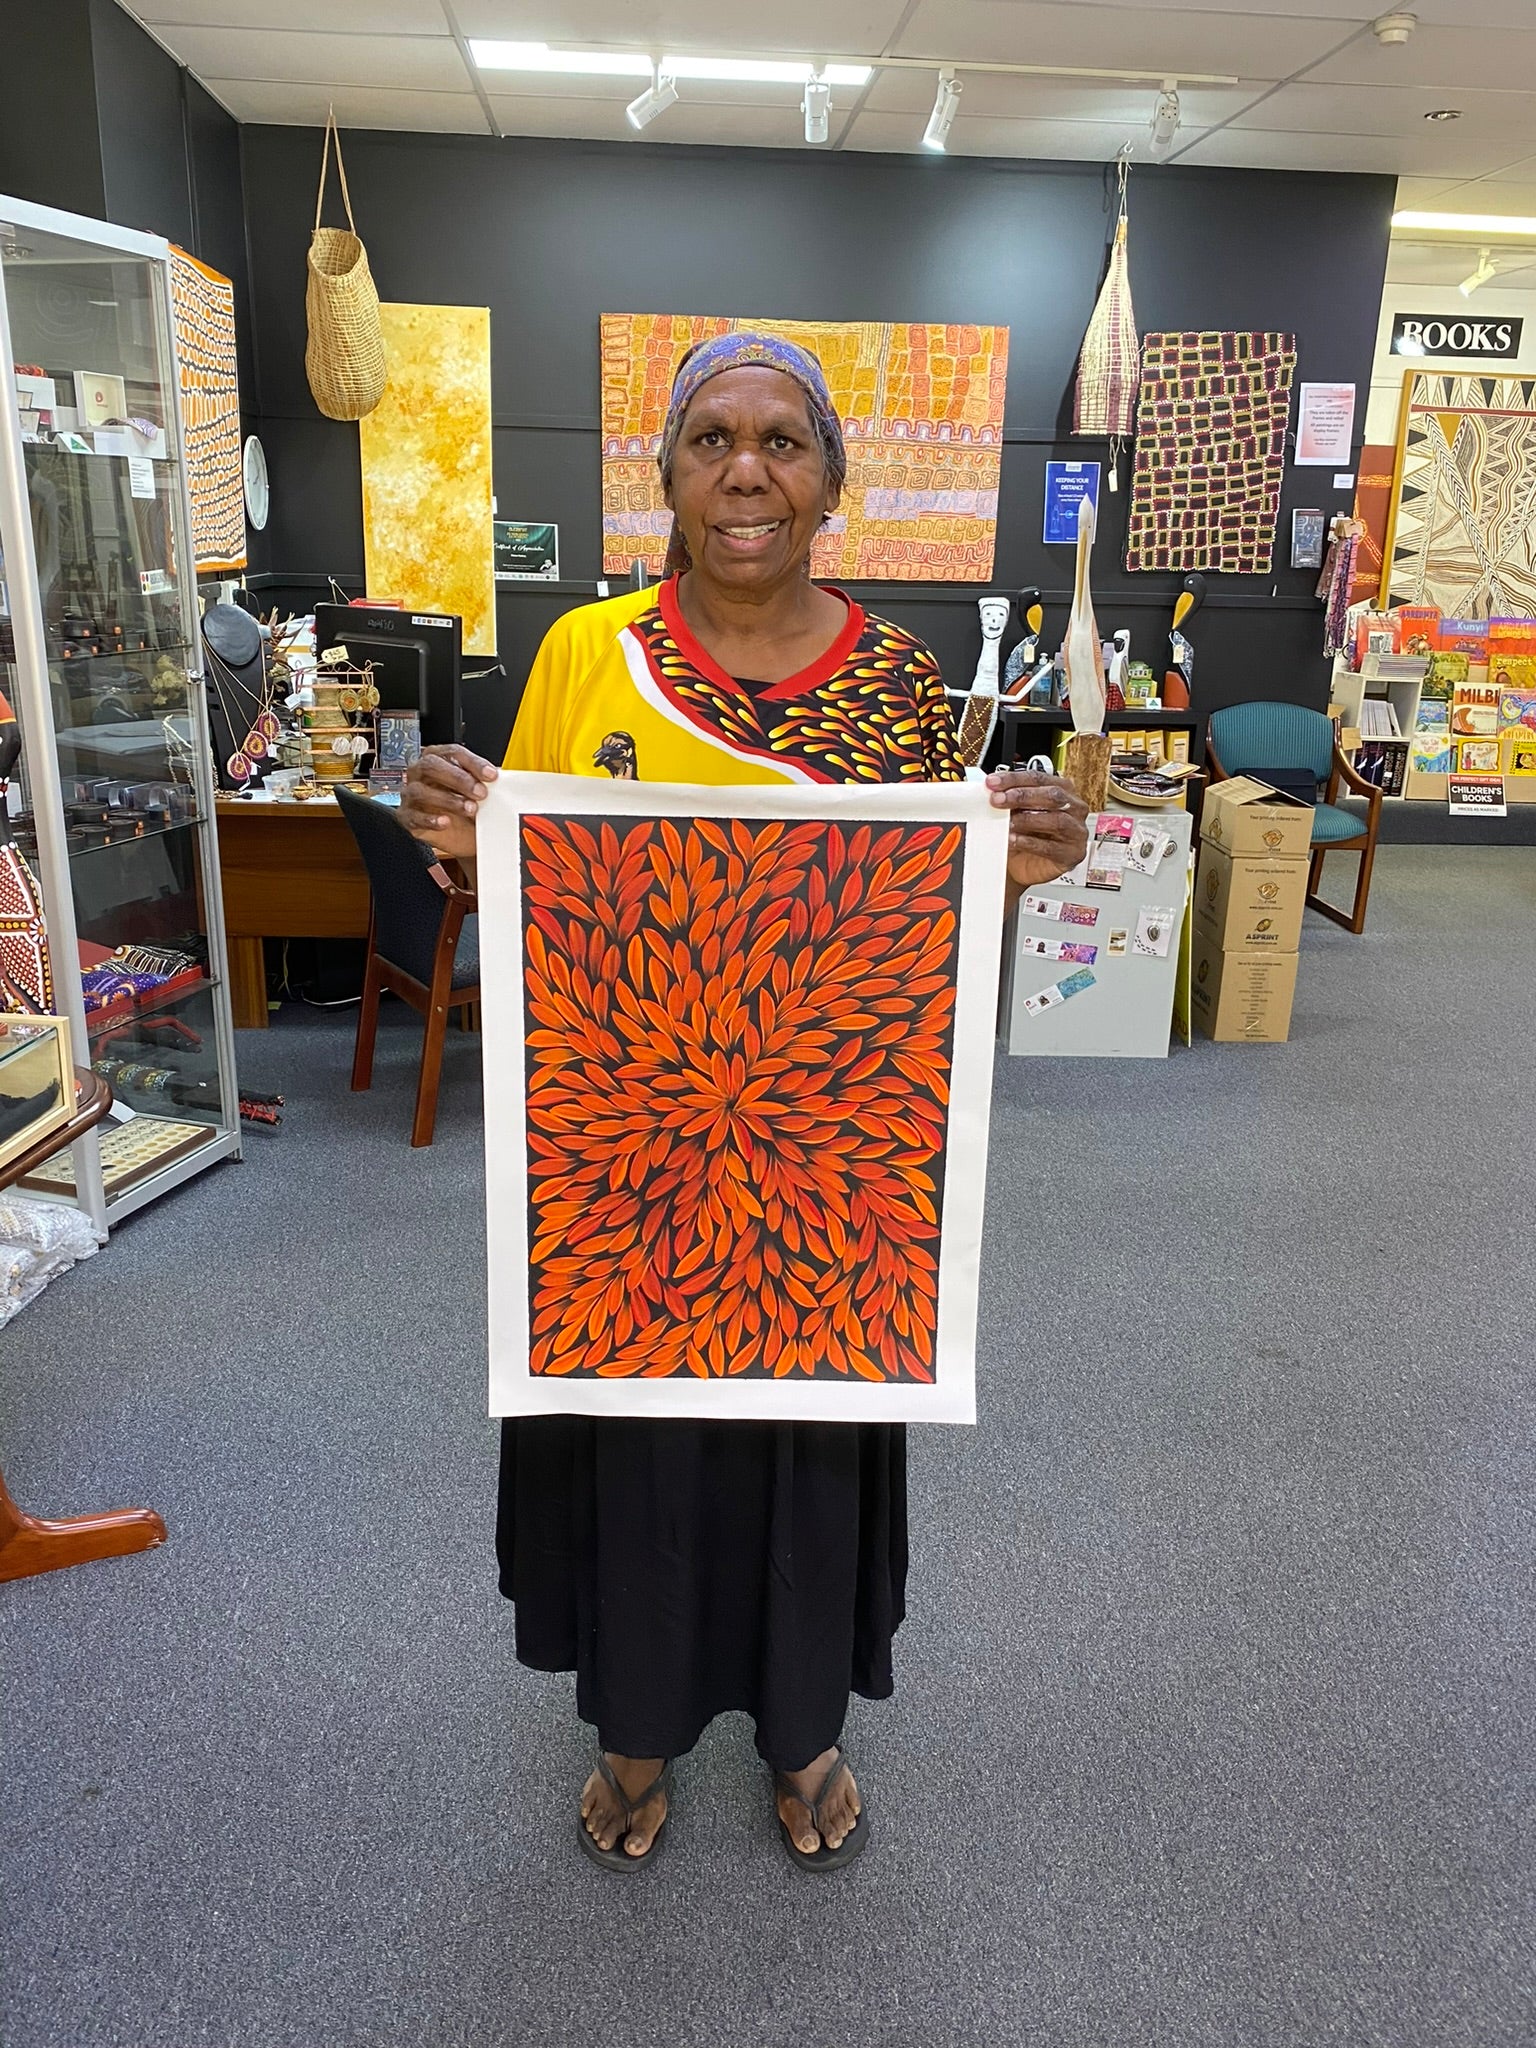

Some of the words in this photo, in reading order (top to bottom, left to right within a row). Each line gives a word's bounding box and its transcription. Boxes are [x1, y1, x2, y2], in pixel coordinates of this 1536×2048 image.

[1402, 321, 1512, 351] BOOKS
[1496, 658, 1533, 667] respect
[1451, 785, 1502, 795] CHILDREN'S
[1462, 794, 1493, 803] BOOKS
